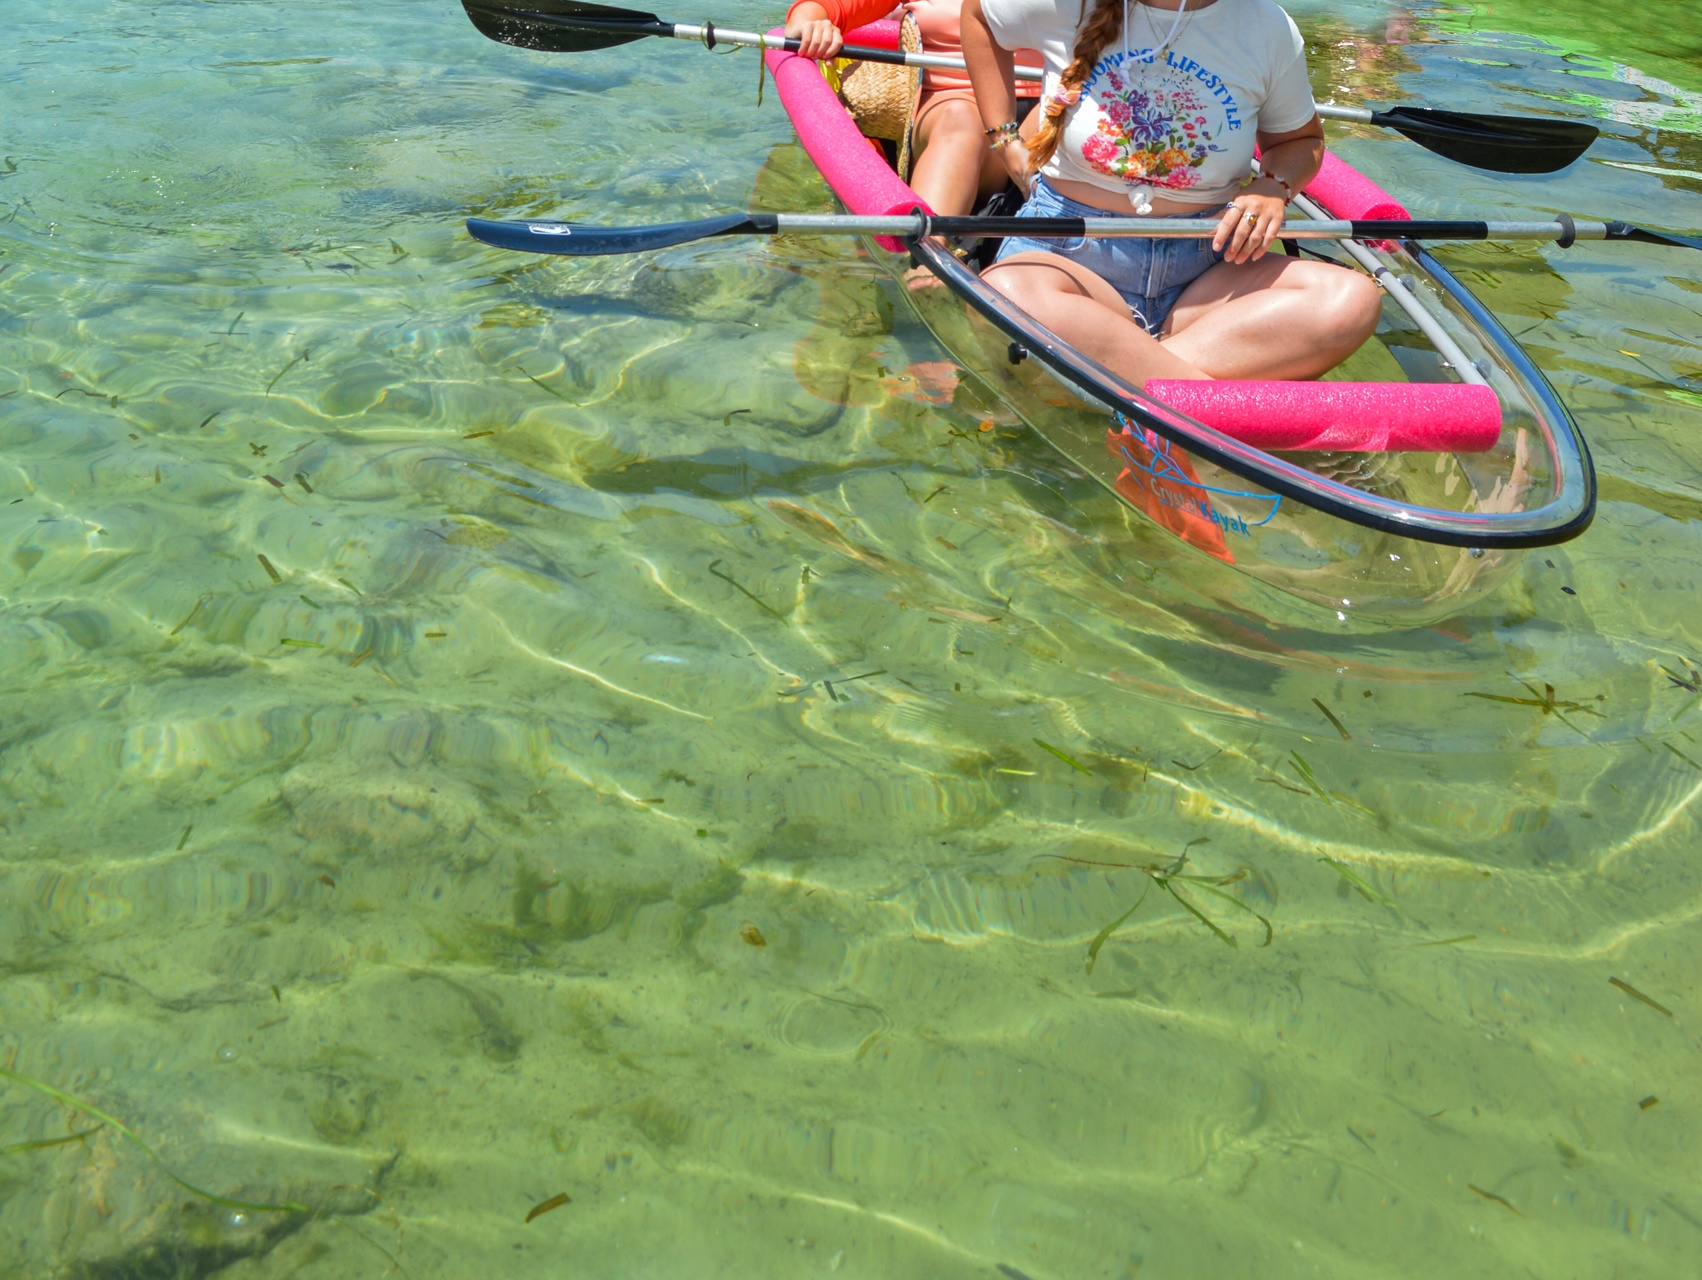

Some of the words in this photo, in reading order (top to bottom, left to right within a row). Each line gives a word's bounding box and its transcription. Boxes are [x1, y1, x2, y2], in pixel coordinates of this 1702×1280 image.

[1166, 51, 1242, 131] LIFESTYLE
[1150, 477, 1198, 515] Crystal
[1198, 500, 1251, 536] Kayak
